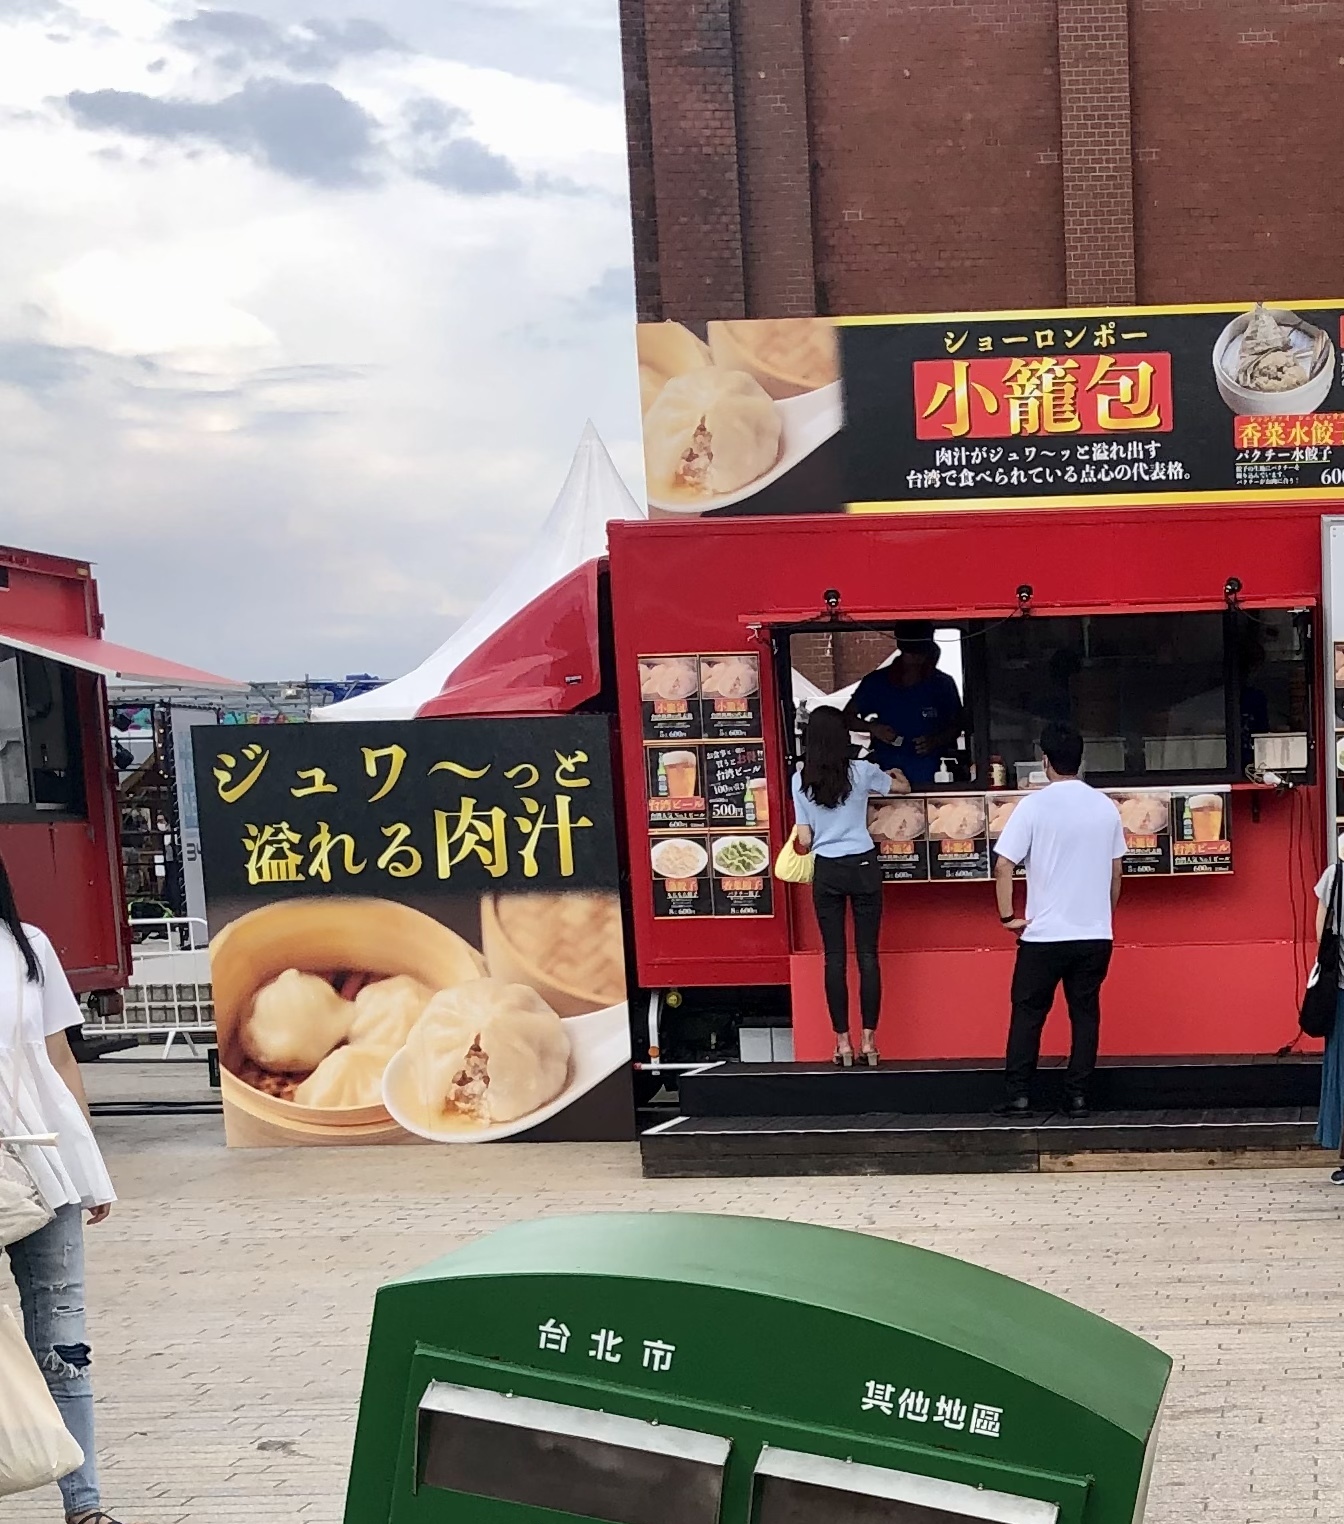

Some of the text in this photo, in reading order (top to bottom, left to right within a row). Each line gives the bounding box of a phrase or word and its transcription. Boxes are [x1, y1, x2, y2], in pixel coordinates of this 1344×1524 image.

[944, 321, 1148, 354] ショーロンポー
[921, 354, 1161, 437] 小籠包
[906, 462, 1191, 489] 台湾で食べられている点心の代表格。
[1236, 446, 1332, 462] パクチー水餃子
[213, 743, 591, 803] ジュワ〜っと
[712, 804, 743, 816] 500円
[242, 794, 594, 885] 溢れる肉汁
[538, 1318, 676, 1371] 台北市
[861, 1380, 1003, 1438] 其他地區
